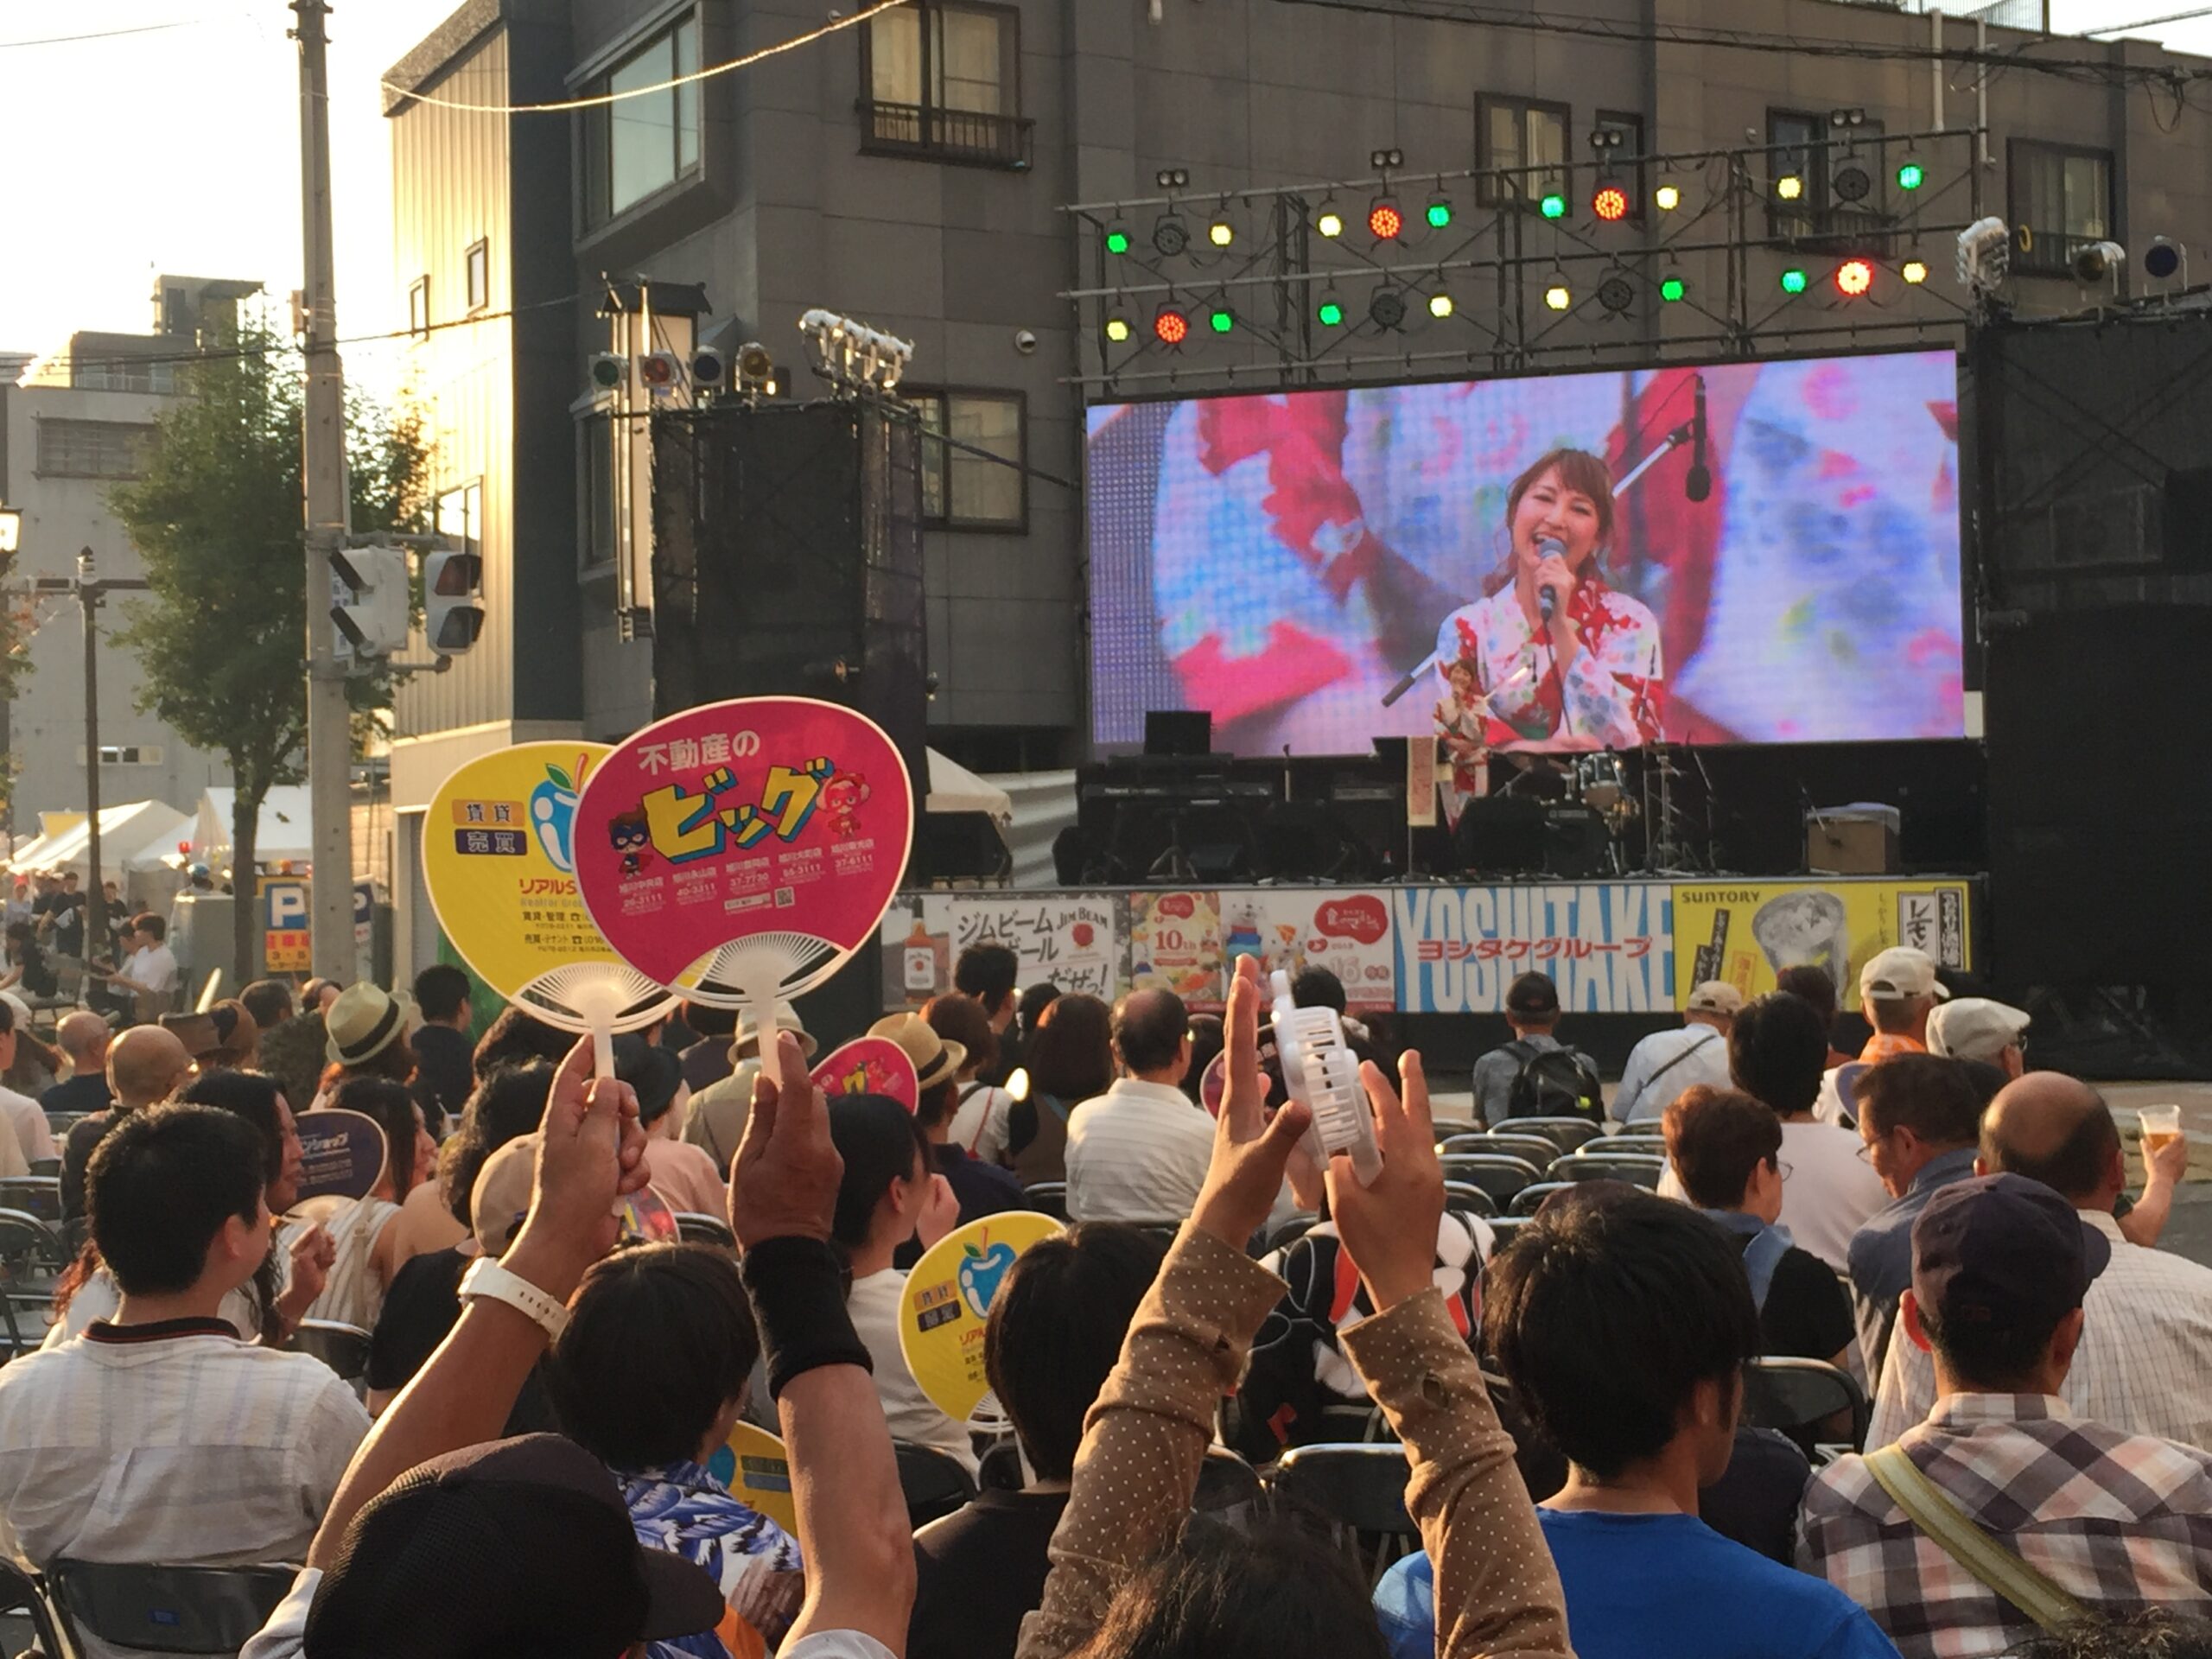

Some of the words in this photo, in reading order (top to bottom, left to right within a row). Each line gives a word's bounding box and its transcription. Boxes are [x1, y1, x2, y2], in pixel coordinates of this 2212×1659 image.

[637, 730, 761, 776] 不動産の
[466, 803, 512, 823] 賃貸
[642, 757, 835, 864] ビッグ
[467, 830, 516, 854] 売買
[270, 887, 306, 927] P
[957, 907, 1054, 944] ジムビーム
[1078, 907, 1108, 930] BEAM
[1393, 885, 1674, 1013] YOSHITAKE
[1417, 935, 1653, 961] ヨシタケグループ
